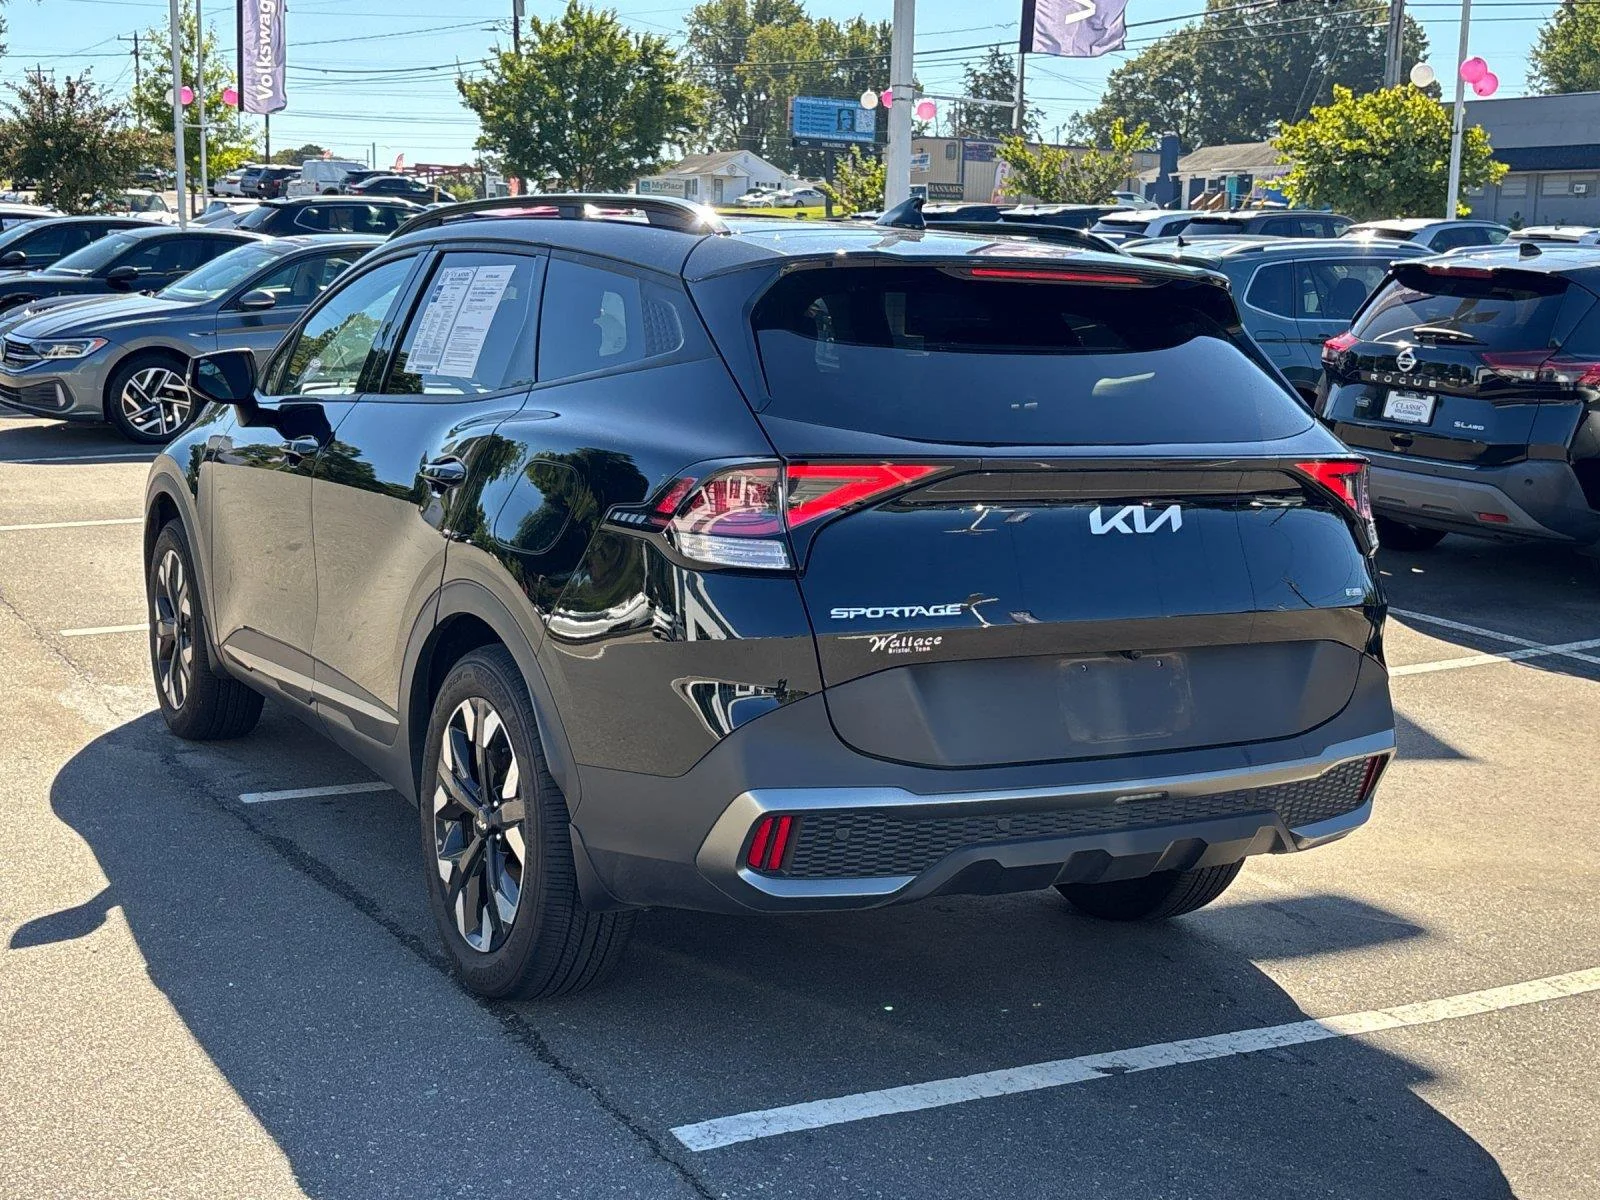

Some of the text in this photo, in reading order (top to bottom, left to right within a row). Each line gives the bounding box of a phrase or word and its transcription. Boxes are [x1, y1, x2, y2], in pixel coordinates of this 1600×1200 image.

[1370, 373, 1437, 388] ROGUE
[830, 603, 962, 619] SPORTAGE
[869, 633, 943, 653] Wallace
